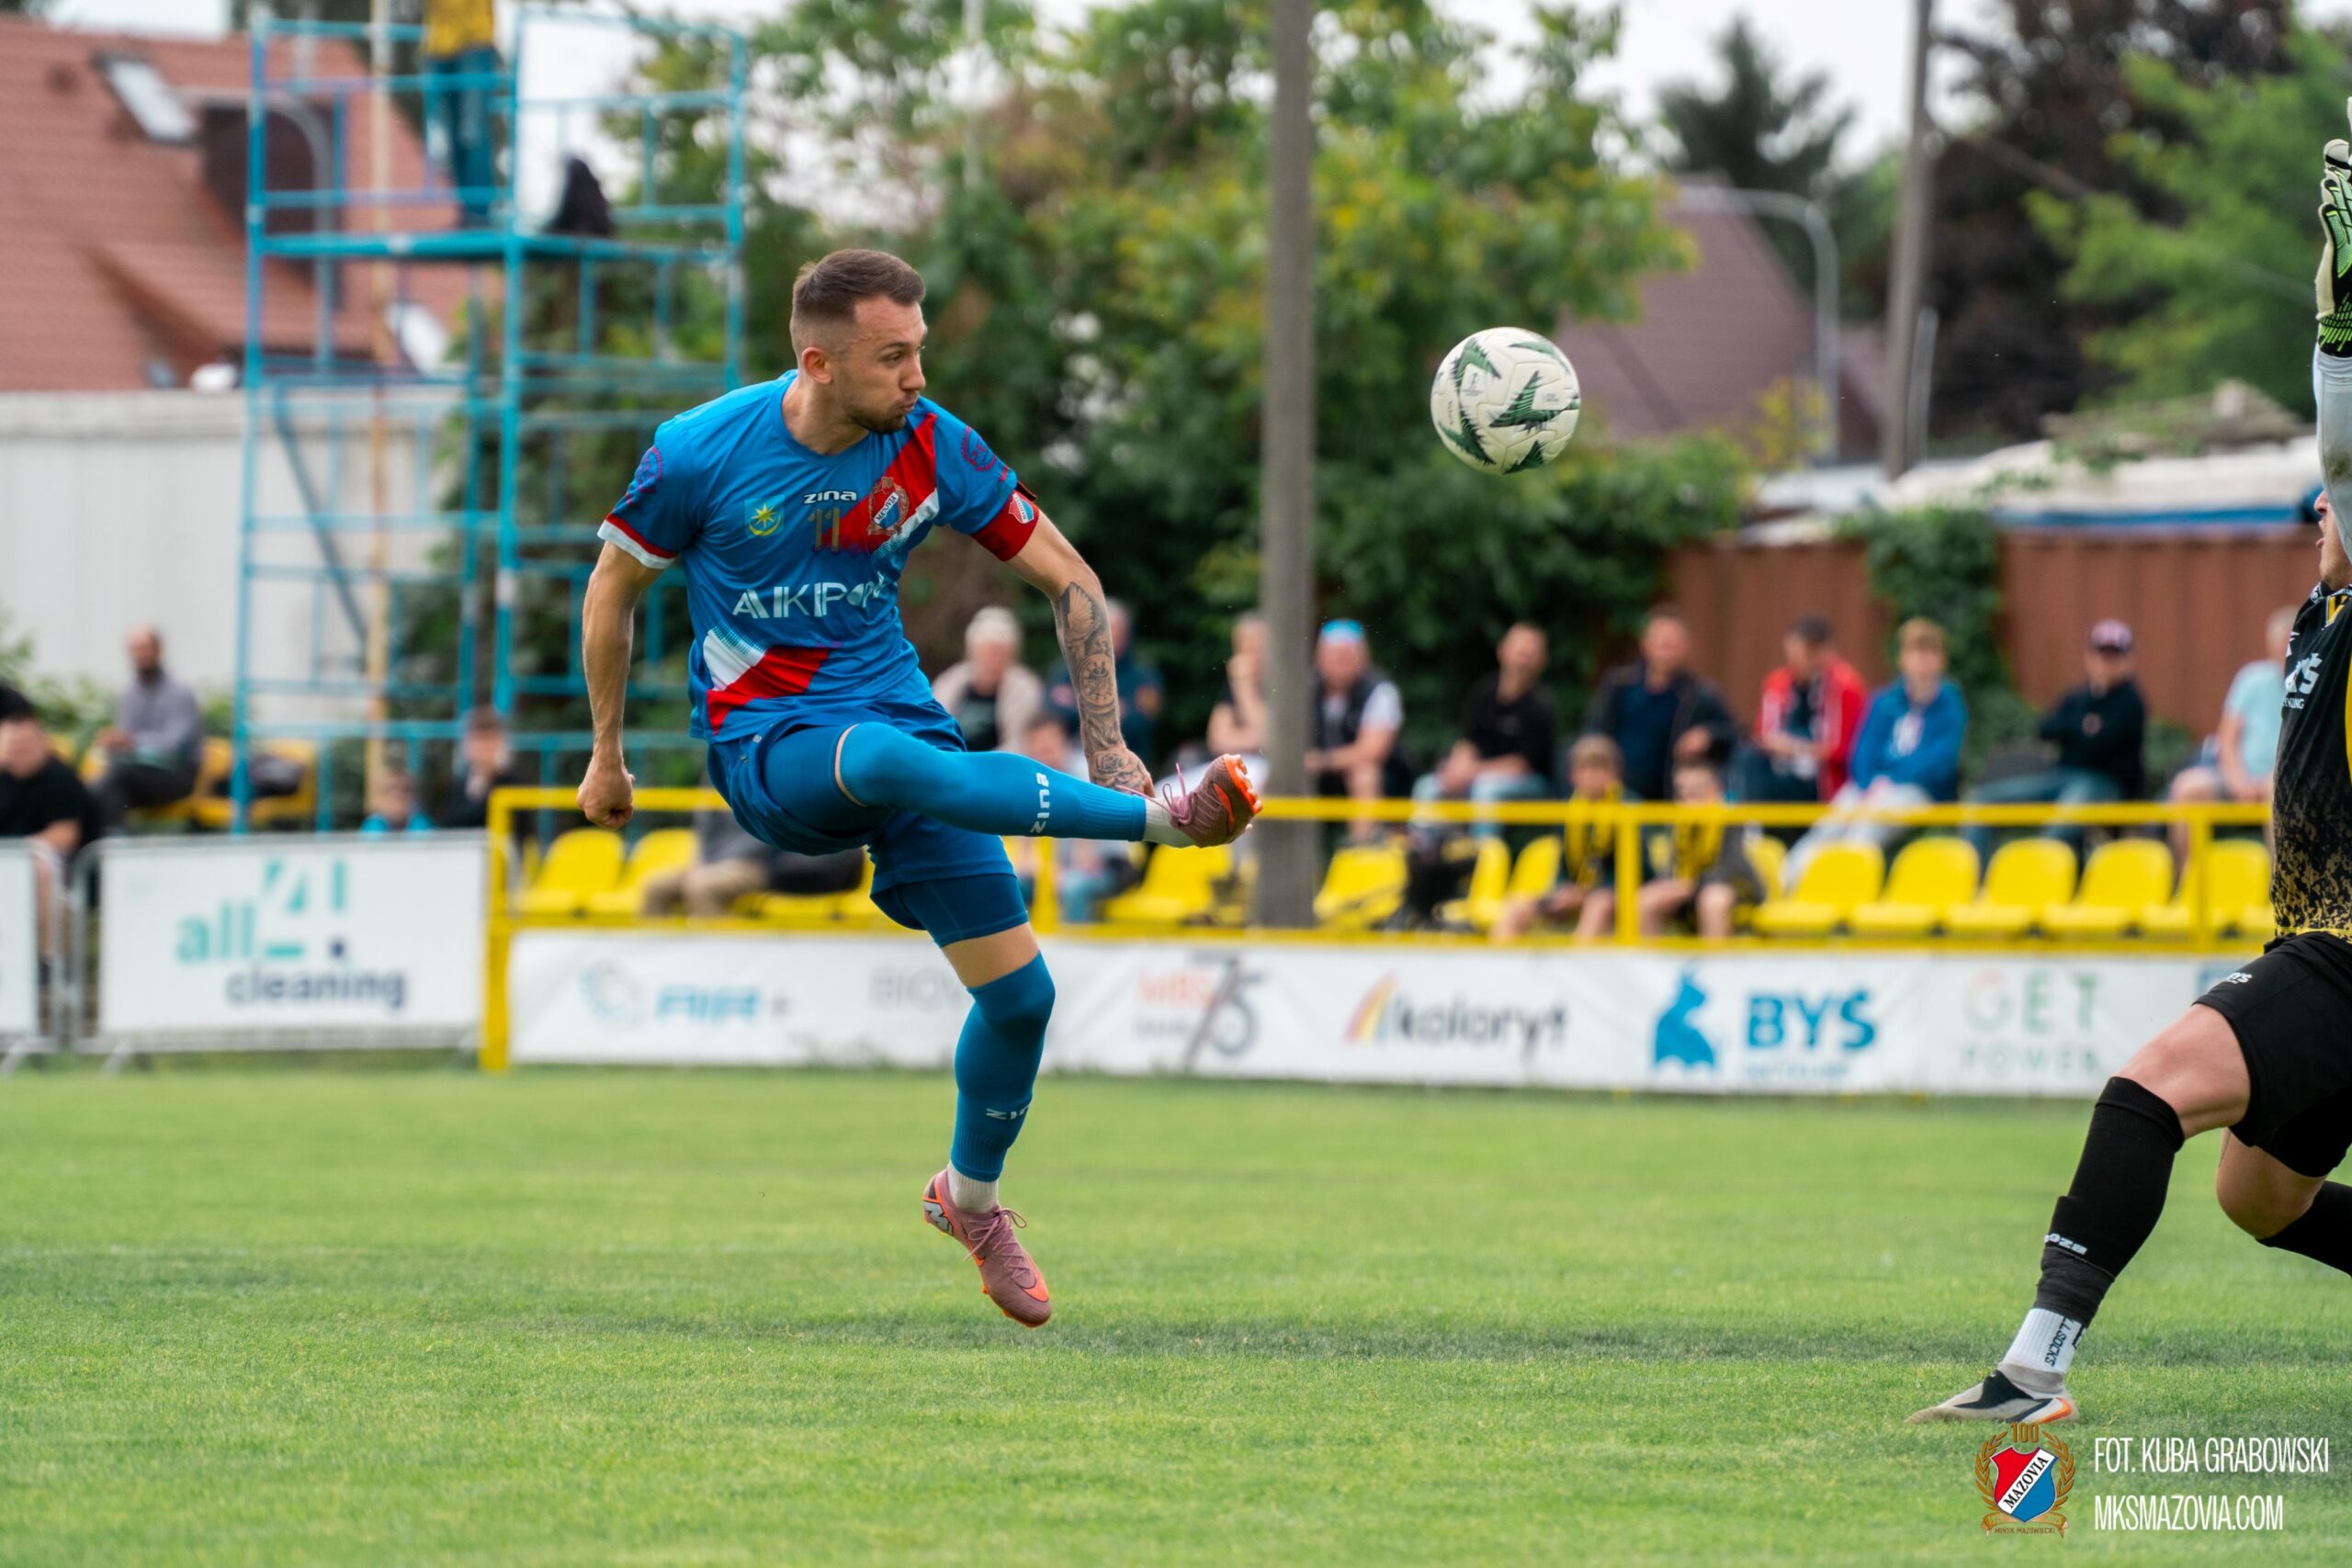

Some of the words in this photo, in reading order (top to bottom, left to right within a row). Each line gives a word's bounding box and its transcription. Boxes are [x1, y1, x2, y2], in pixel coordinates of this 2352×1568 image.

[803, 491, 857, 504] zina
[808, 506, 841, 551] 11
[224, 967, 407, 1008] cleaning
[1962, 970, 2100, 1034] GET
[1396, 992, 1568, 1062] koloryt
